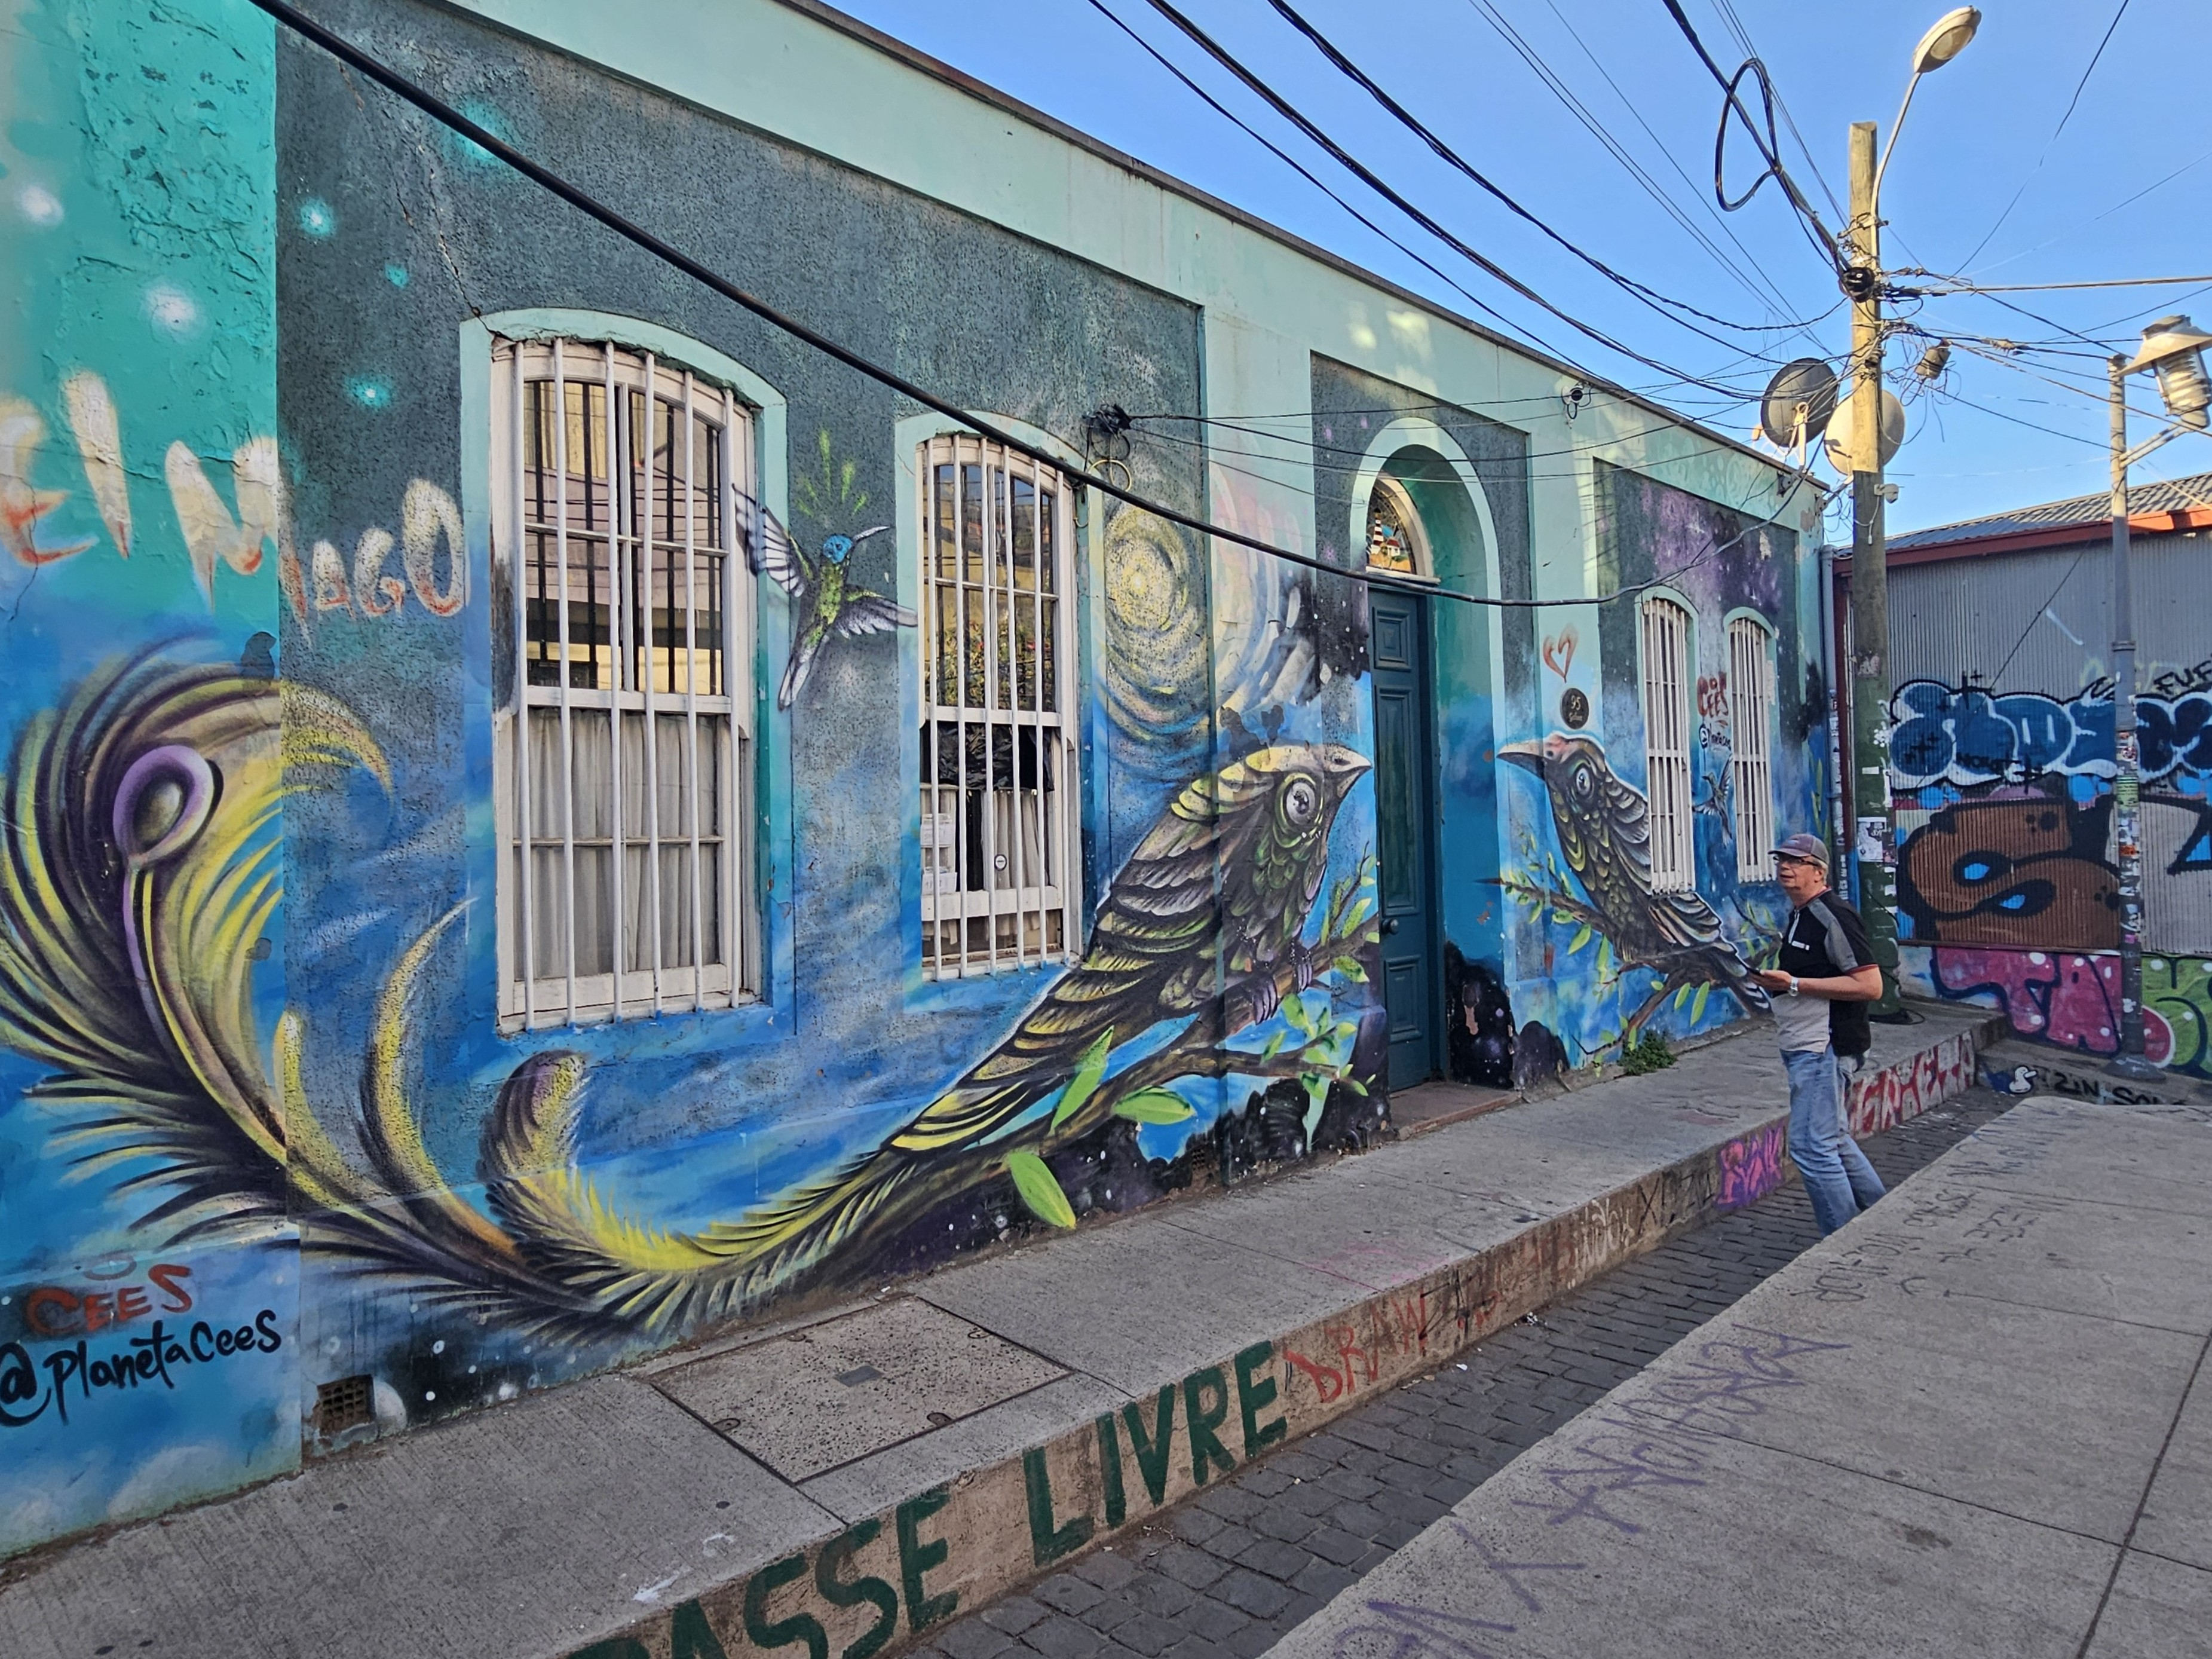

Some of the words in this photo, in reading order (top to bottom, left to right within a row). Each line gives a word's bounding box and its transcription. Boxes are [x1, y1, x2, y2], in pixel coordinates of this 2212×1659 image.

[1571, 695, 1581, 711] 95
[26, 1263, 194, 1337] CEES
[565, 1483, 960, 1659] ASSE
[1022, 1340, 1288, 1566] LIVRE
